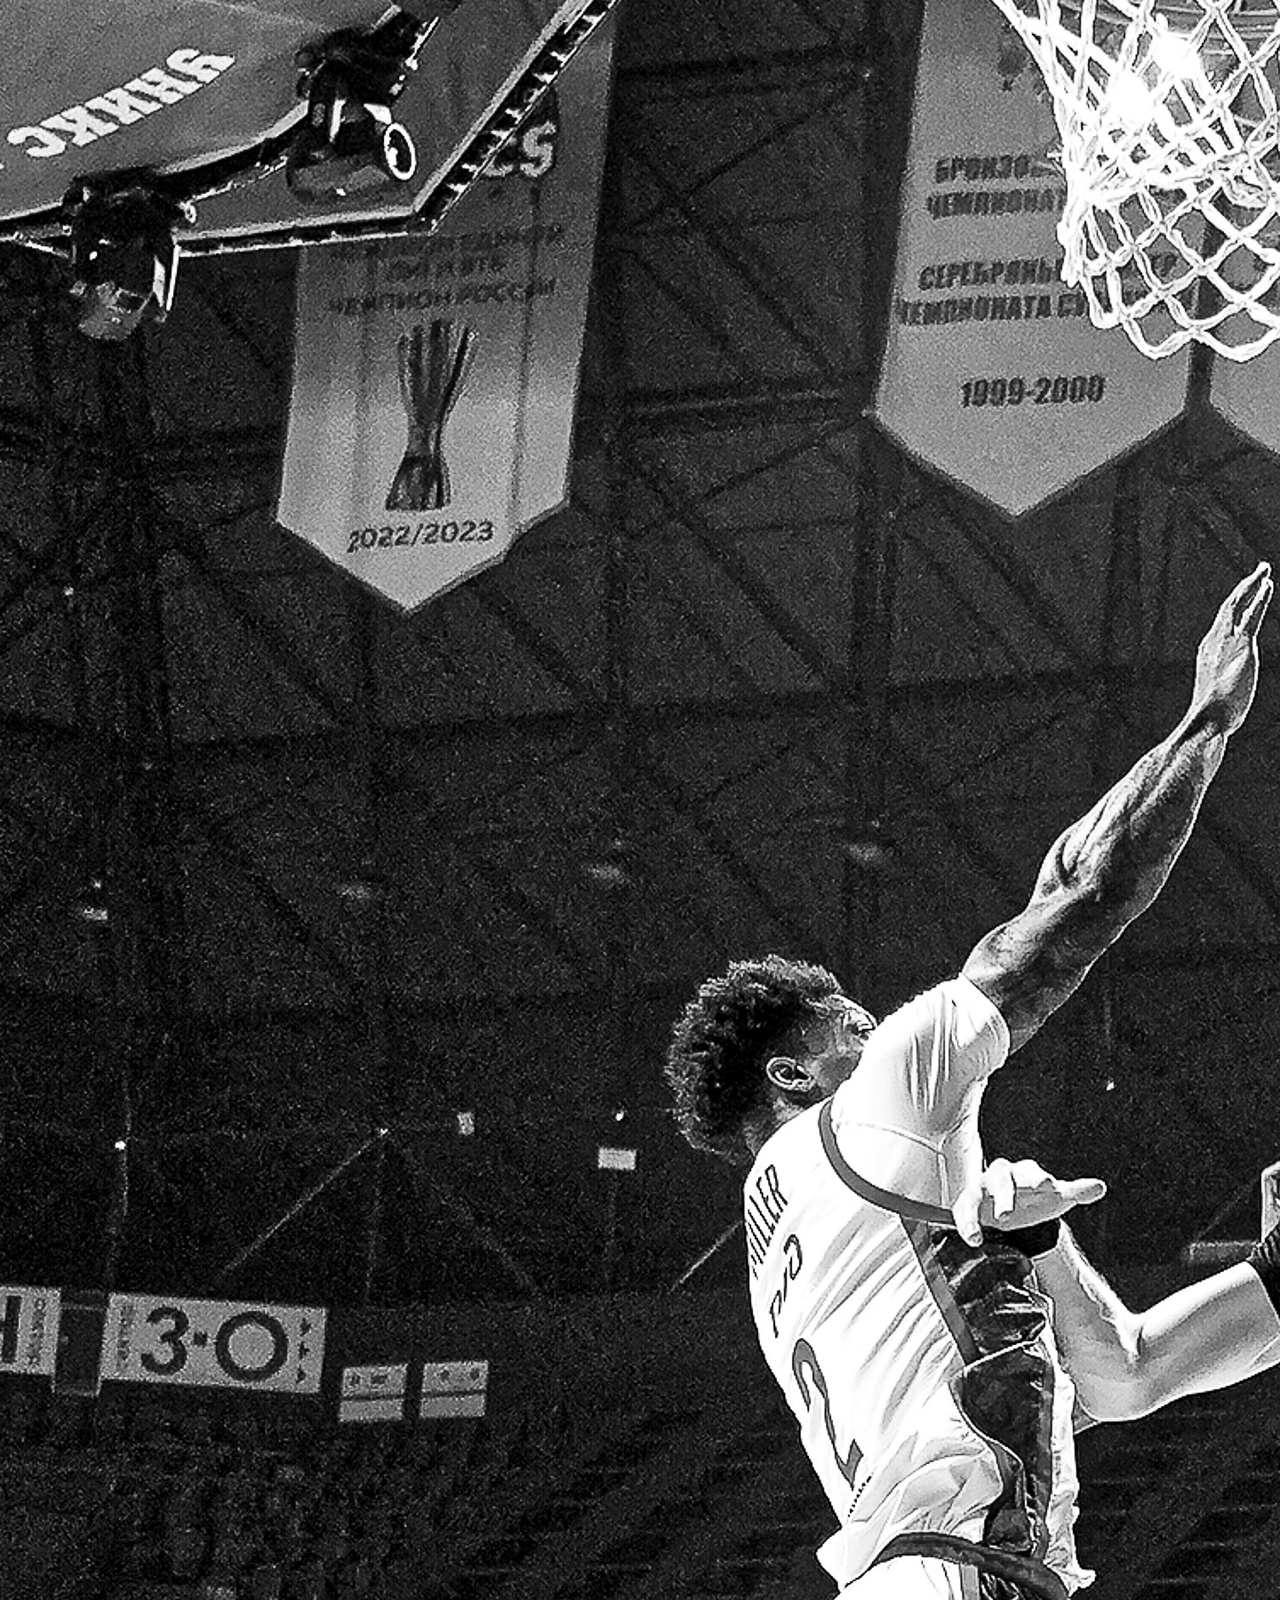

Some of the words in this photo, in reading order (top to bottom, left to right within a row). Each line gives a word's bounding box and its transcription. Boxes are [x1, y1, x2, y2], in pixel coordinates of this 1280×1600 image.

[927, 188, 1067, 220] ЧЕМПИОНАТ
[918, 257, 1064, 291] СЕРЕБРЯНЫ
[961, 374, 1105, 408] 1999-2000
[347, 521, 494, 554] 2022/2023
[792, 1337, 864, 1491] 2
